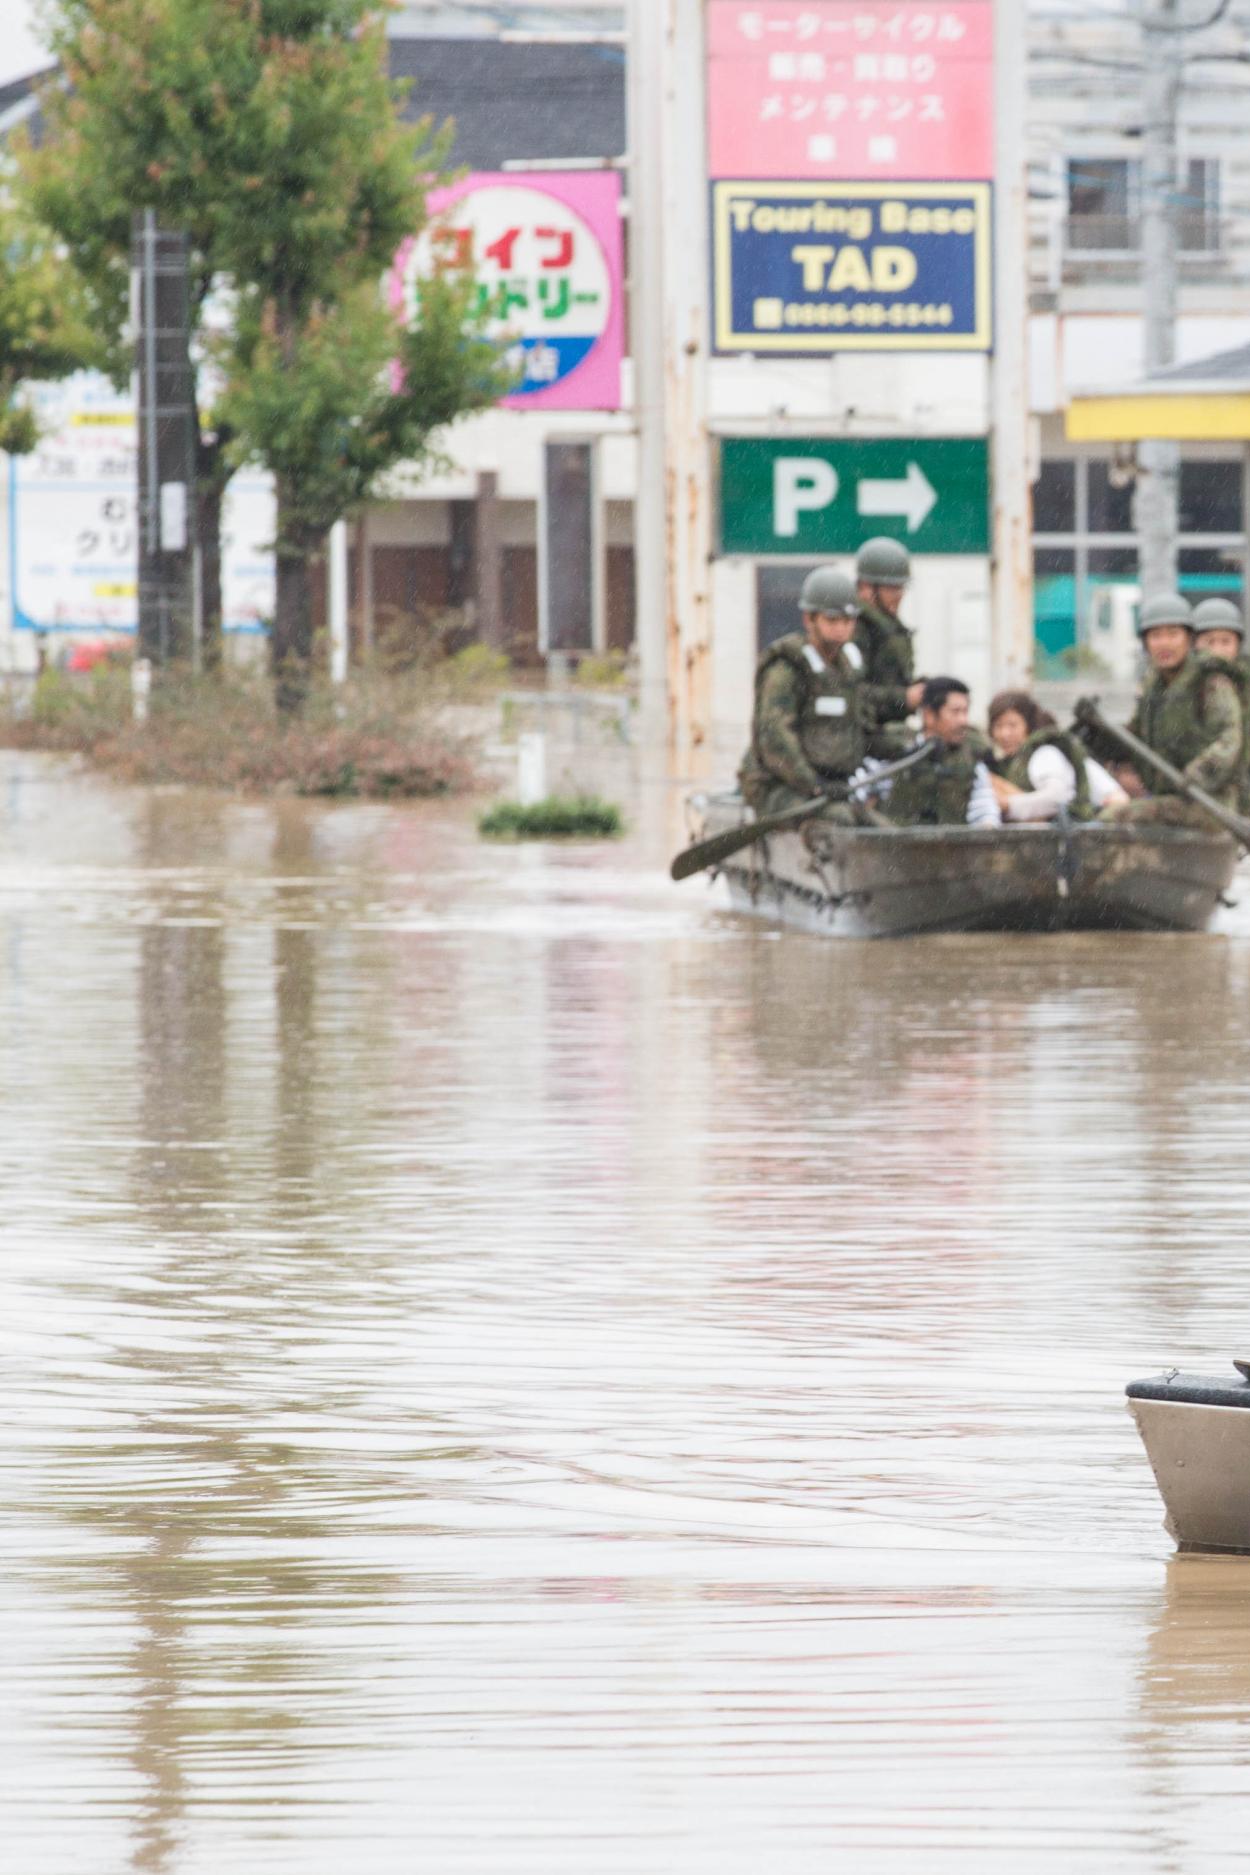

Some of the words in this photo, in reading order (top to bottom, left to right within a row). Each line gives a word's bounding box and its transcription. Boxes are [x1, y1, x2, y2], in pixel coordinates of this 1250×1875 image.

[730, 200, 872, 240] Touring
[880, 201, 974, 234] Base
[791, 245, 918, 293] TAD
[772, 456, 840, 537] P
